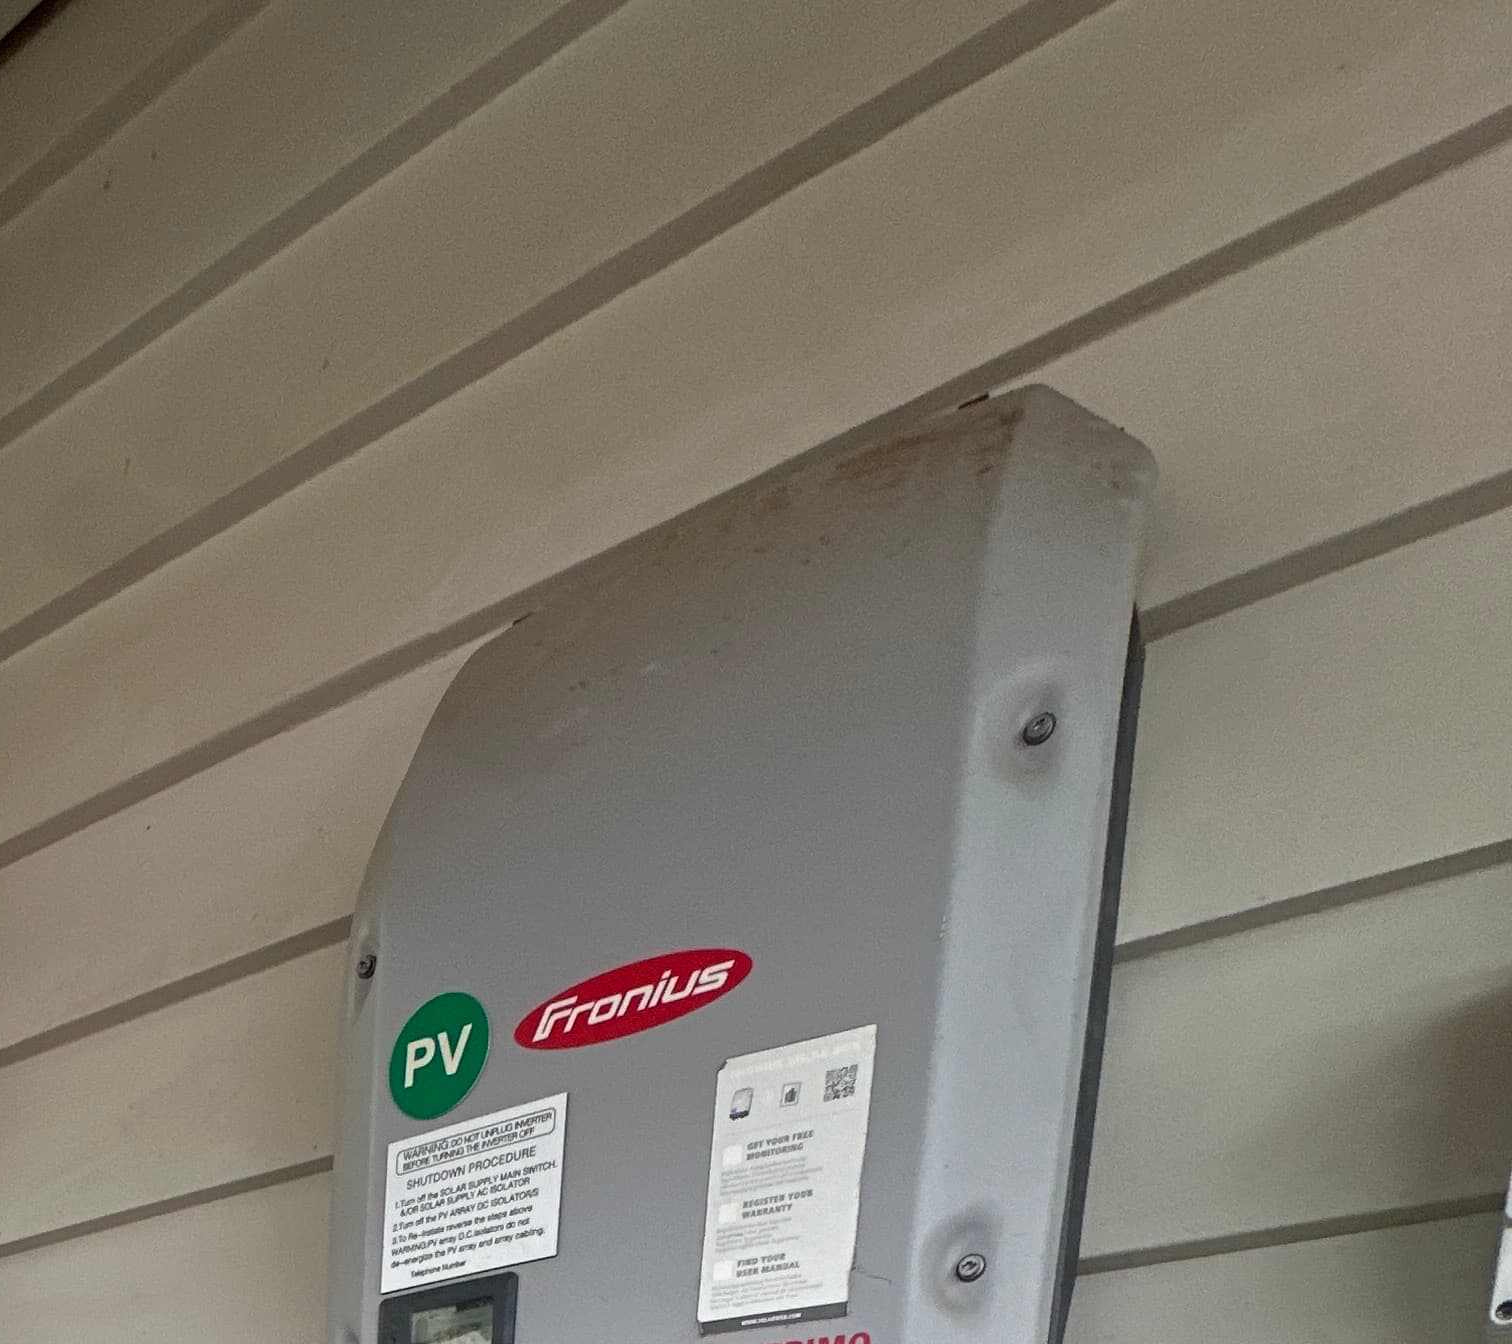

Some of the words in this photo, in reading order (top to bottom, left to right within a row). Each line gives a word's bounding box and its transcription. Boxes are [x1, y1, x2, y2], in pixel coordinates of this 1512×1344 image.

[531, 957, 736, 1044] Fronius
[403, 1022, 473, 1090] PV
[451, 1137, 463, 1148] DO
[464, 1132, 480, 1144] NOT
[481, 1122, 513, 1139] UNPLUG
[515, 1112, 553, 1129] INVERTER
[747, 1139, 764, 1151] GET
[766, 1134, 790, 1147] YOUR
[792, 1129, 814, 1140] FREE
[403, 1156, 430, 1171] BEFORE
[432, 1146, 464, 1161] TURNING
[466, 1142, 479, 1153] THE
[481, 1132, 518, 1149] INVERTER
[746, 1142, 804, 1161] MONITORING
[406, 1164, 466, 1190] SHUTDOWN
[468, 1145, 537, 1173] PROCEDURE
[419, 1199, 445, 1212] SOLAR
[447, 1190, 476, 1205] SUPPLY
[476, 1186, 489, 1197] AC
[490, 1176, 530, 1194] ISOLATOR
[427, 1191, 438, 1200] the
[440, 1183, 467, 1197] SOLAR
[468, 1173, 498, 1190] SUPPLY
[500, 1168, 522, 1181] MAIN
[742, 1194, 785, 1209] REGISTER
[788, 1189, 813, 1201] YOUR
[426, 1215, 437, 1224] the
[438, 1211, 448, 1220] PV
[450, 1203, 476, 1217] ARRAY
[477, 1200, 489, 1211] DC
[474, 1215, 486, 1225] the
[518, 1217, 530, 1227] not
[741, 1204, 792, 1220] WARRANTY
[435, 1249, 446, 1259] the
[447, 1244, 458, 1255] PV
[737, 1257, 758, 1268] FIND
[761, 1253, 786, 1264] YOUR
[411, 1265, 441, 1278] Telephone
[442, 1259, 467, 1271] Number
[736, 1267, 758, 1278] USER
[761, 1261, 800, 1274] MANUAL
